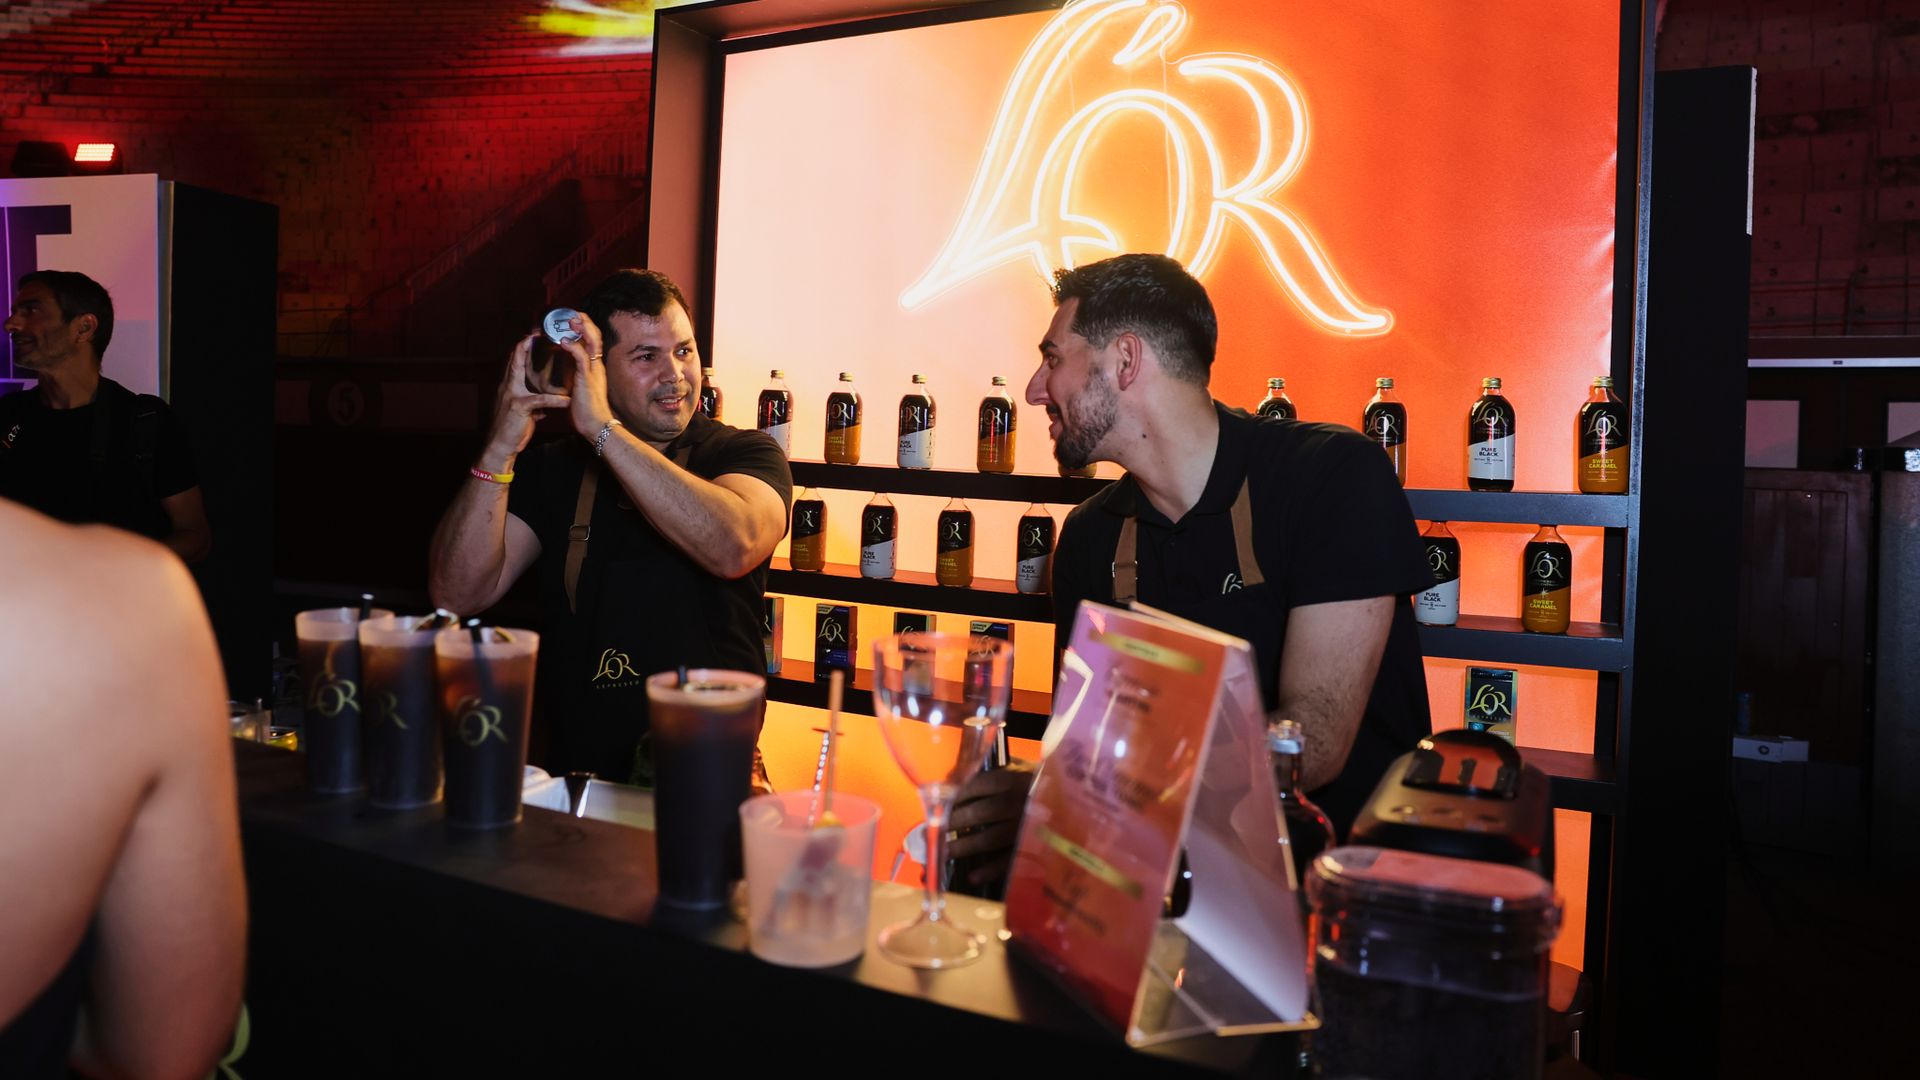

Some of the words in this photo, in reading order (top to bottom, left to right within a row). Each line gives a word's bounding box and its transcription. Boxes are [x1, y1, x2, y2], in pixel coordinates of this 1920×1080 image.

[1527, 550, 1563, 578] L'OR
[591, 648, 641, 682] L'OR
[1469, 684, 1512, 716] L'OR
